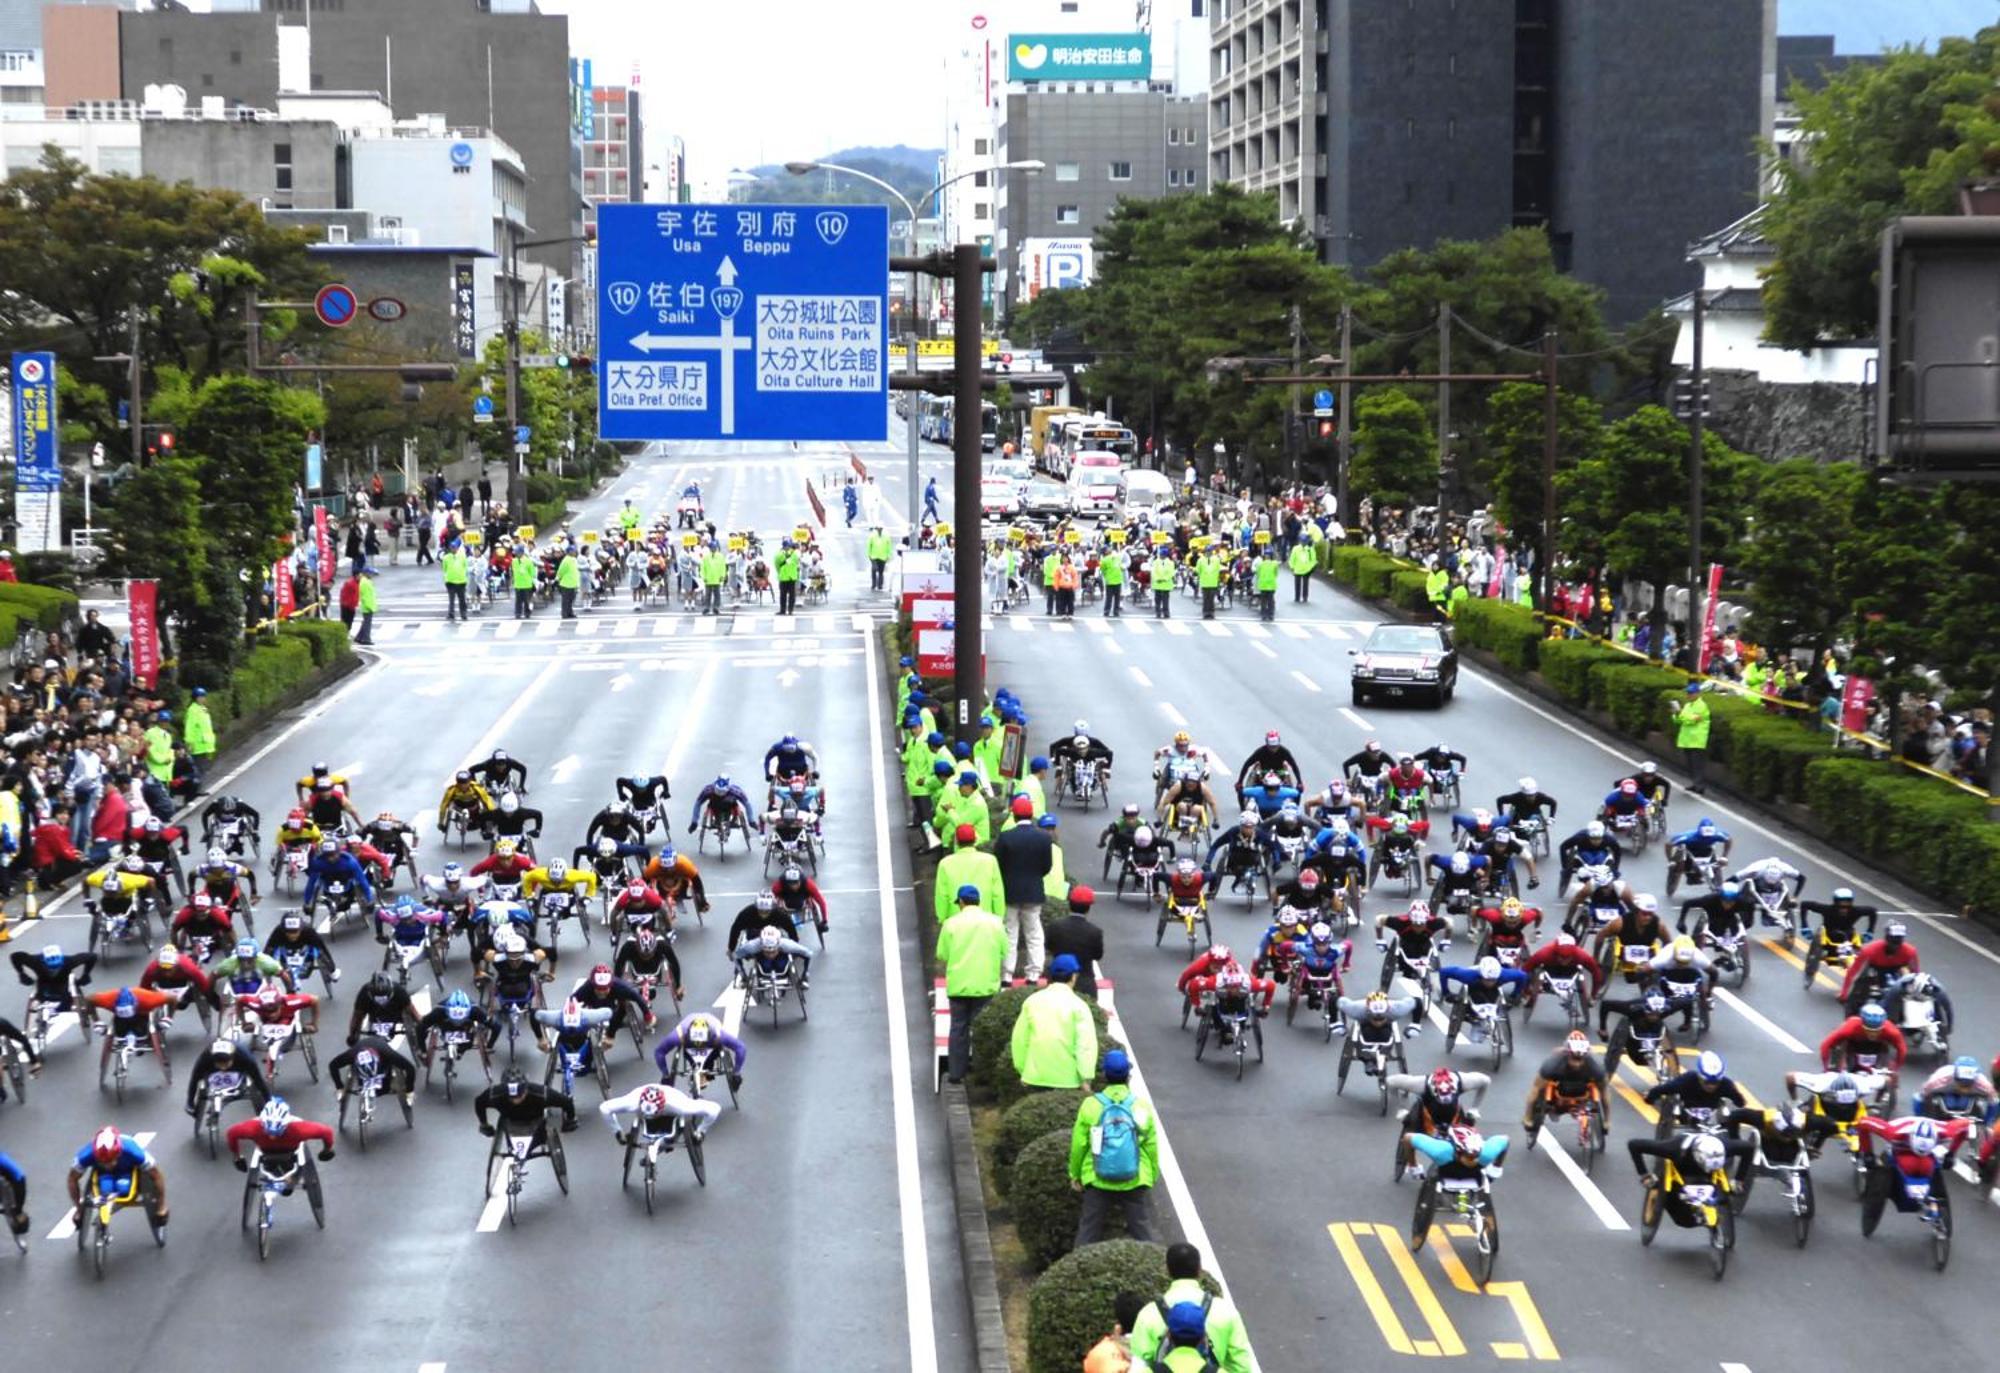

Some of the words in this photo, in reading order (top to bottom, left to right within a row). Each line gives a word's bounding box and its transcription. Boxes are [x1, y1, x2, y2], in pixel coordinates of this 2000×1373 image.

[1052, 47, 1142, 65] 明治安田生命
[657, 211, 717, 237] 宇佐
[736, 211, 796, 237] 別府
[820, 217, 841, 233] 10
[673, 239, 701, 252] Usa
[743, 240, 790, 256] Beppu
[613, 287, 634, 303] 10
[647, 282, 705, 307] 佐伯
[716, 293, 738, 308] 197
[658, 310, 695, 324] Saiki
[760, 300, 877, 325] 大分城址公園
[768, 327, 794, 341] Oita
[799, 327, 834, 341] Ruins
[842, 327, 871, 341] Park
[760, 348, 877, 372] 大分文化会館
[611, 366, 703, 390] 大分県庁
[764, 375, 790, 388] Oita
[795, 375, 843, 388] Culture
[849, 375, 874, 388] Hall
[611, 393, 635, 407] Oita
[639, 393, 666, 407] Pref.
[669, 393, 703, 407] Office
[213, 1075, 232, 1086] 26
[1697, 1188, 1705, 1197] 5
